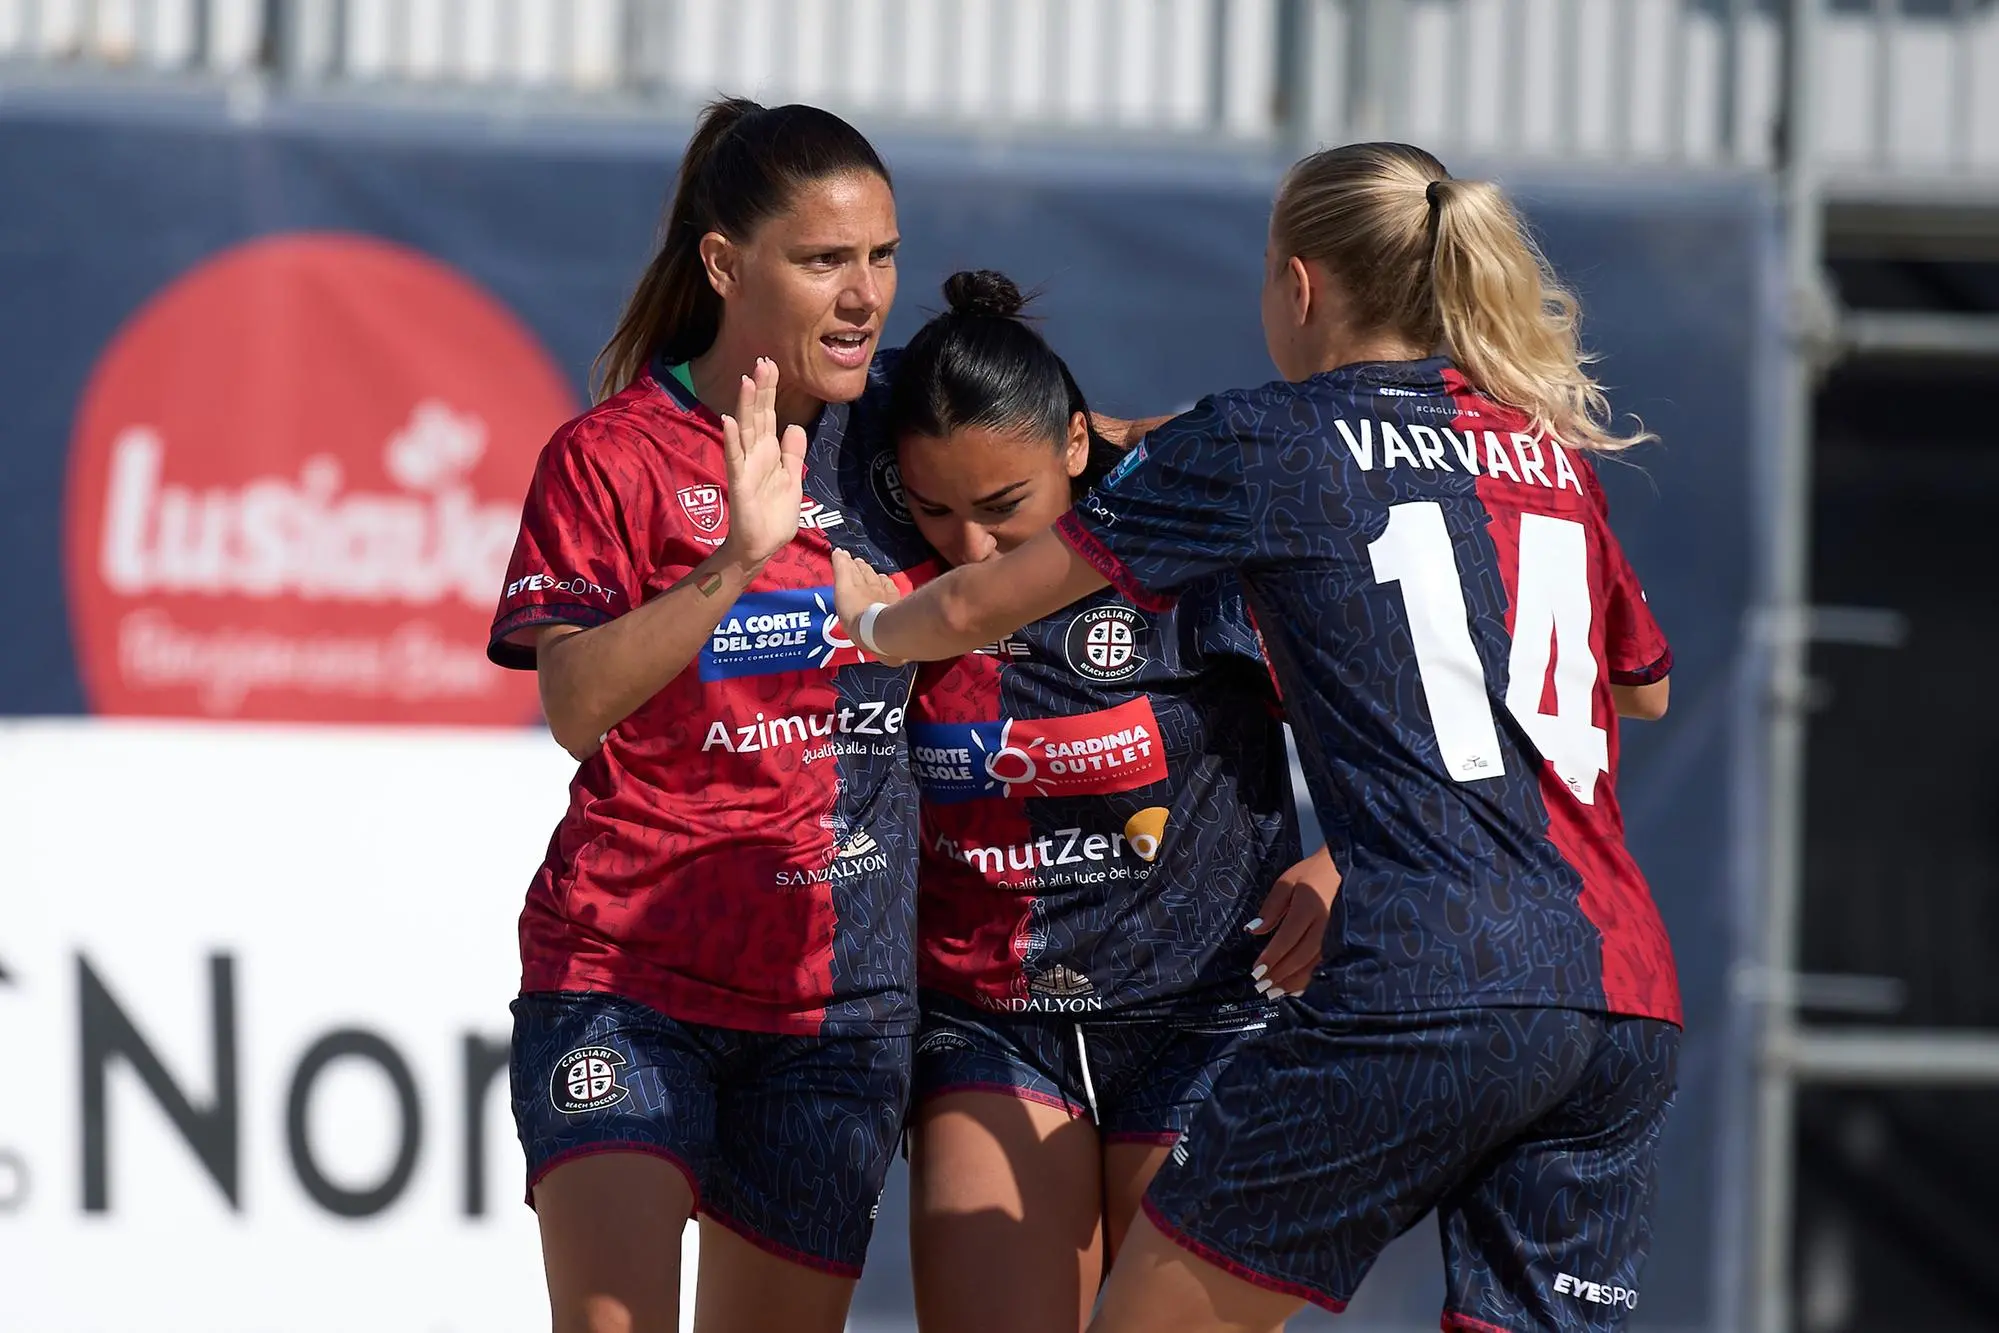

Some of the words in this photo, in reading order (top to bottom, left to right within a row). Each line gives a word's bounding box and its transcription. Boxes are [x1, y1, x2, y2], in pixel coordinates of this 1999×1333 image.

[1334, 418, 1584, 497] VARVARA
[745, 611, 811, 634] CORTE
[1084, 610, 1135, 623] CAGLIARI
[713, 636, 752, 653] DEL
[755, 630, 807, 649] SOLE
[1368, 500, 1609, 805] 14
[713, 656, 744, 664] CENTRO
[747, 650, 802, 661] COMMERCIALE
[1080, 662, 1104, 677] BEACH
[1106, 664, 1135, 677] SOCCER
[701, 701, 904, 753] AzimutZe
[803, 743, 844, 764] Qualità
[846, 741, 867, 754] alla
[915, 746, 972, 764] CORTE
[1045, 725, 1150, 758] SARDINIA
[927, 765, 974, 781] SOLE
[1050, 742, 1152, 774] OUTLET
[1112, 763, 1153, 779] VILLAGE
[1049, 873, 1072, 887] alla
[1075, 871, 1106, 885] luce
[1109, 865, 1131, 880] del
[975, 990, 1102, 1012] SANDALYON
[924, 1036, 967, 1050] CAGLIARI
[562, 1050, 611, 1067] CAGLIARI
[589, 1093, 618, 1108] SOCCER
[1553, 1272, 1638, 1310] EYESPO
